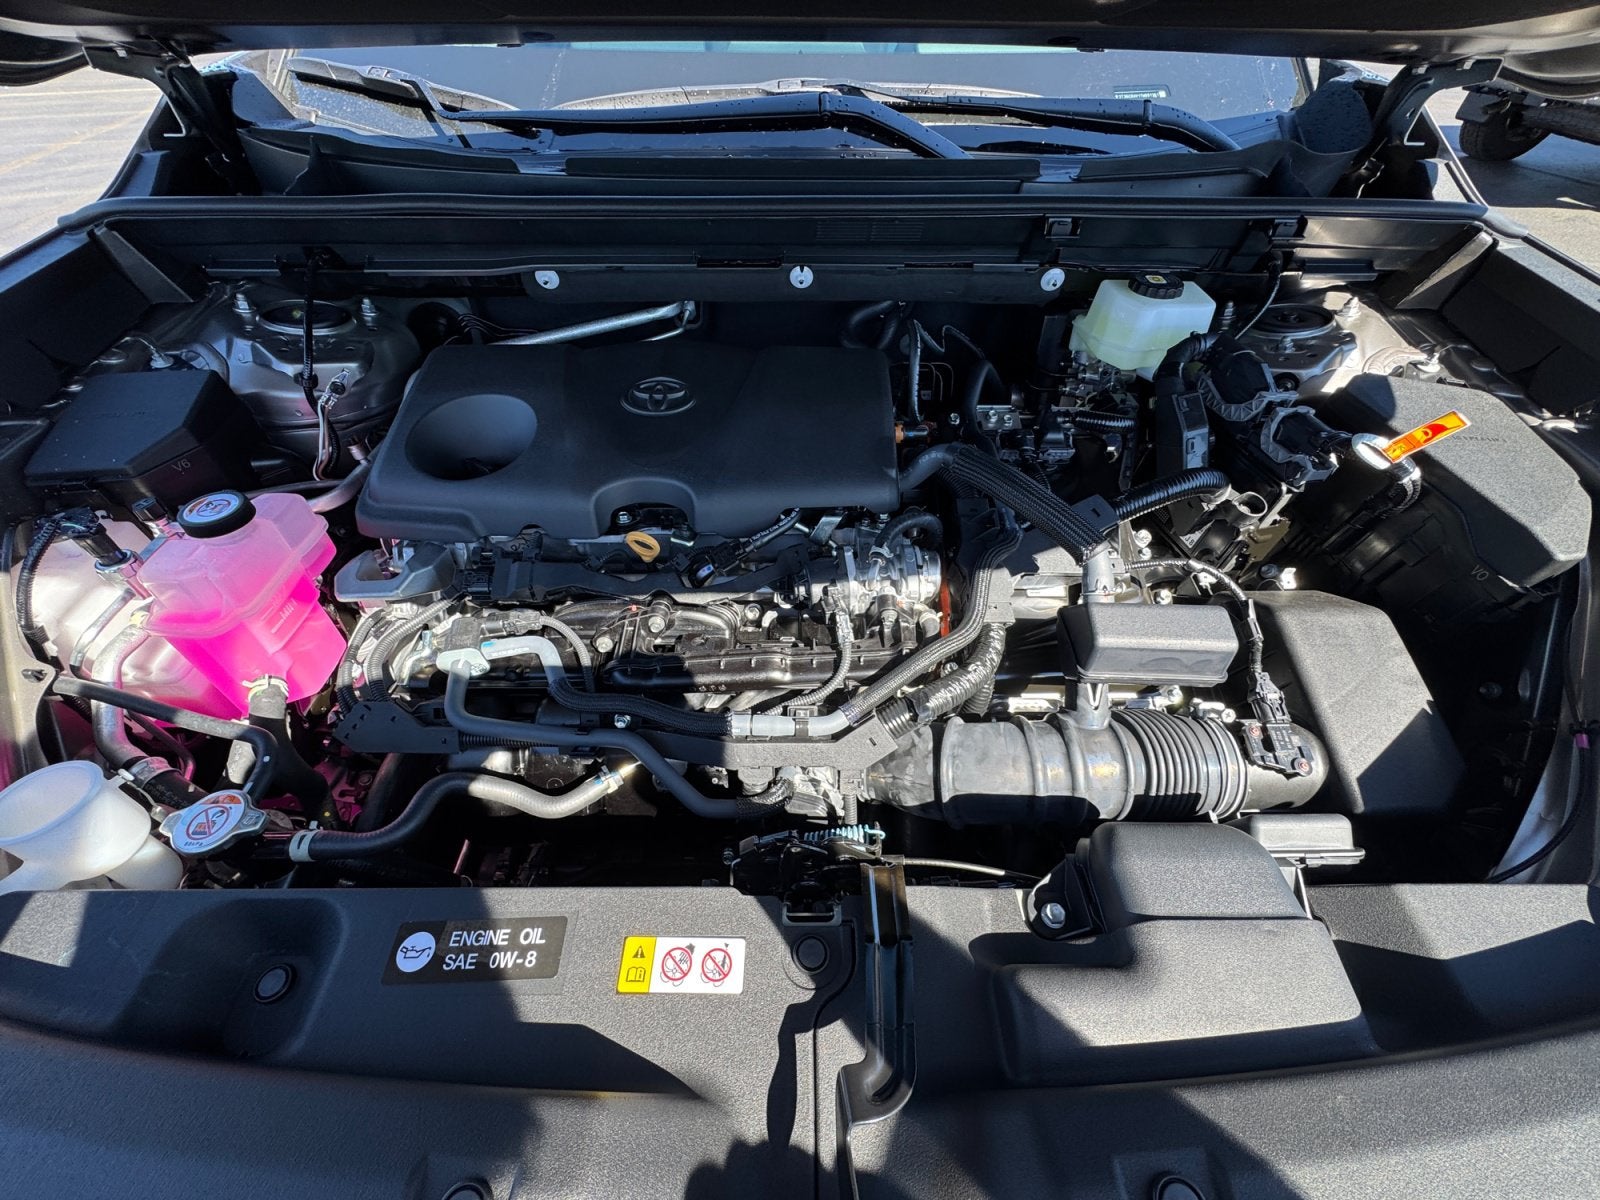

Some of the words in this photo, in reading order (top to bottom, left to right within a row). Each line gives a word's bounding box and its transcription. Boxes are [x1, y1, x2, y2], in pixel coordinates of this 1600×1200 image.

[449, 929, 511, 947] ENGINE
[520, 927, 546, 945] OIL
[442, 953, 479, 971] SAE
[489, 950, 537, 969] 0W-8
